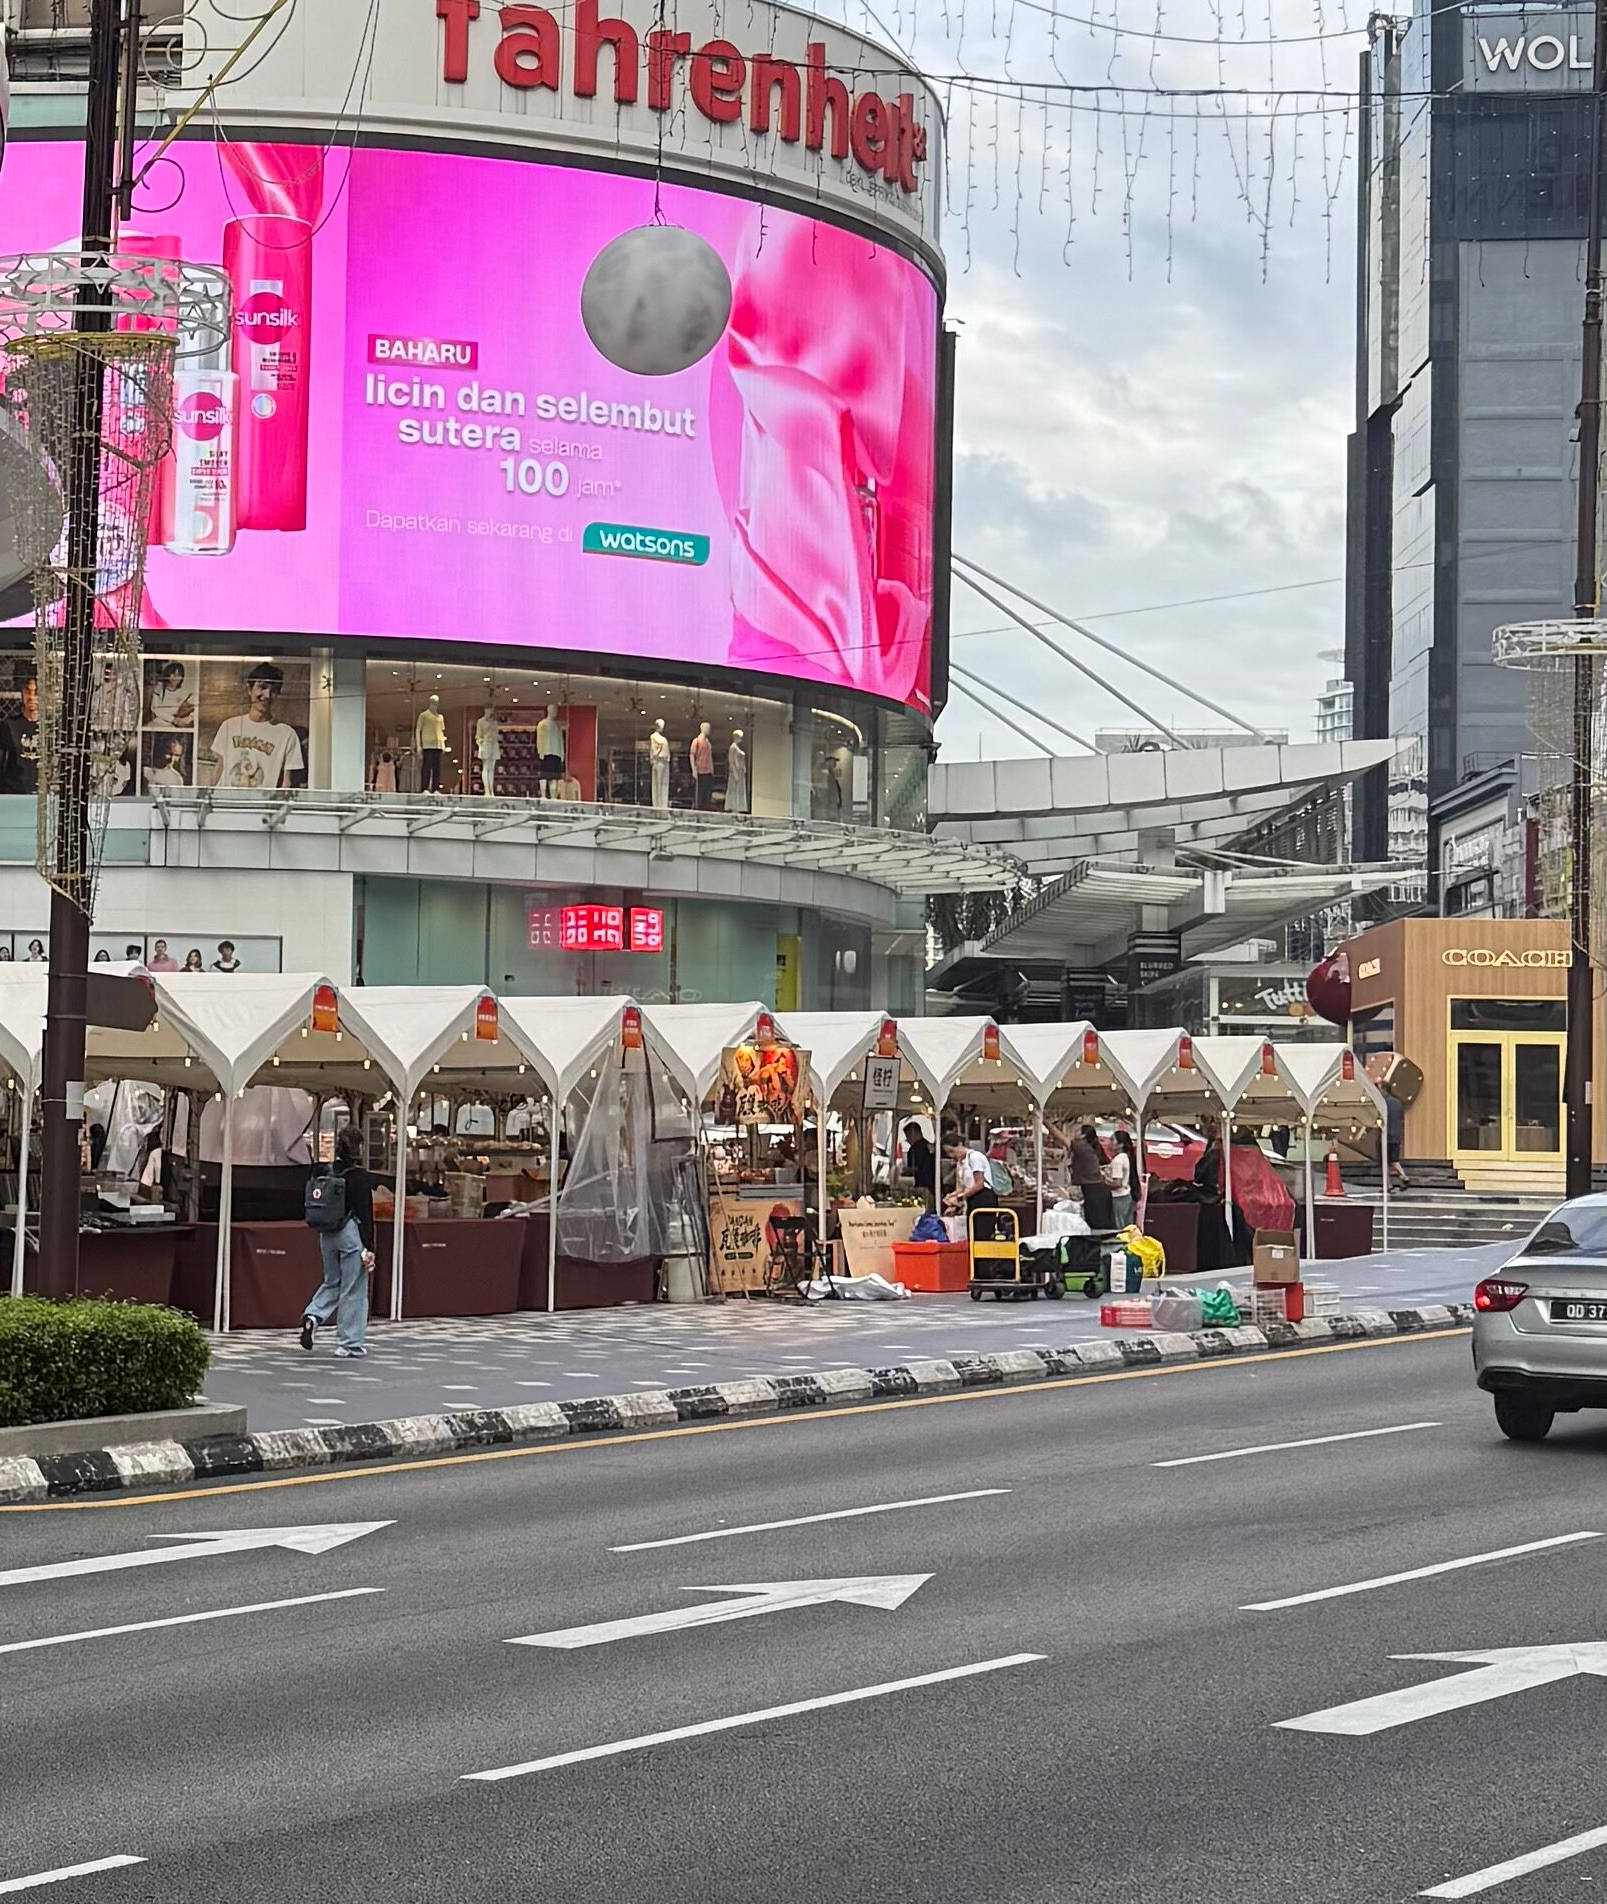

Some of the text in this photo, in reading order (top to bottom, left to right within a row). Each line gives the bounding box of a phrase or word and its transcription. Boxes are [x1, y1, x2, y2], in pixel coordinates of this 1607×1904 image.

[235, 307, 299, 328] sunsilk
[374, 338, 472, 365] BAHARU
[365, 372, 696, 438] licin dan selembut
[398, 415, 603, 461] sutera selama
[500, 456, 569, 497] 100
[365, 508, 574, 543] Dapatkan sekarang di
[598, 528, 695, 558] watsons
[1442, 948, 1573, 968] COACH
